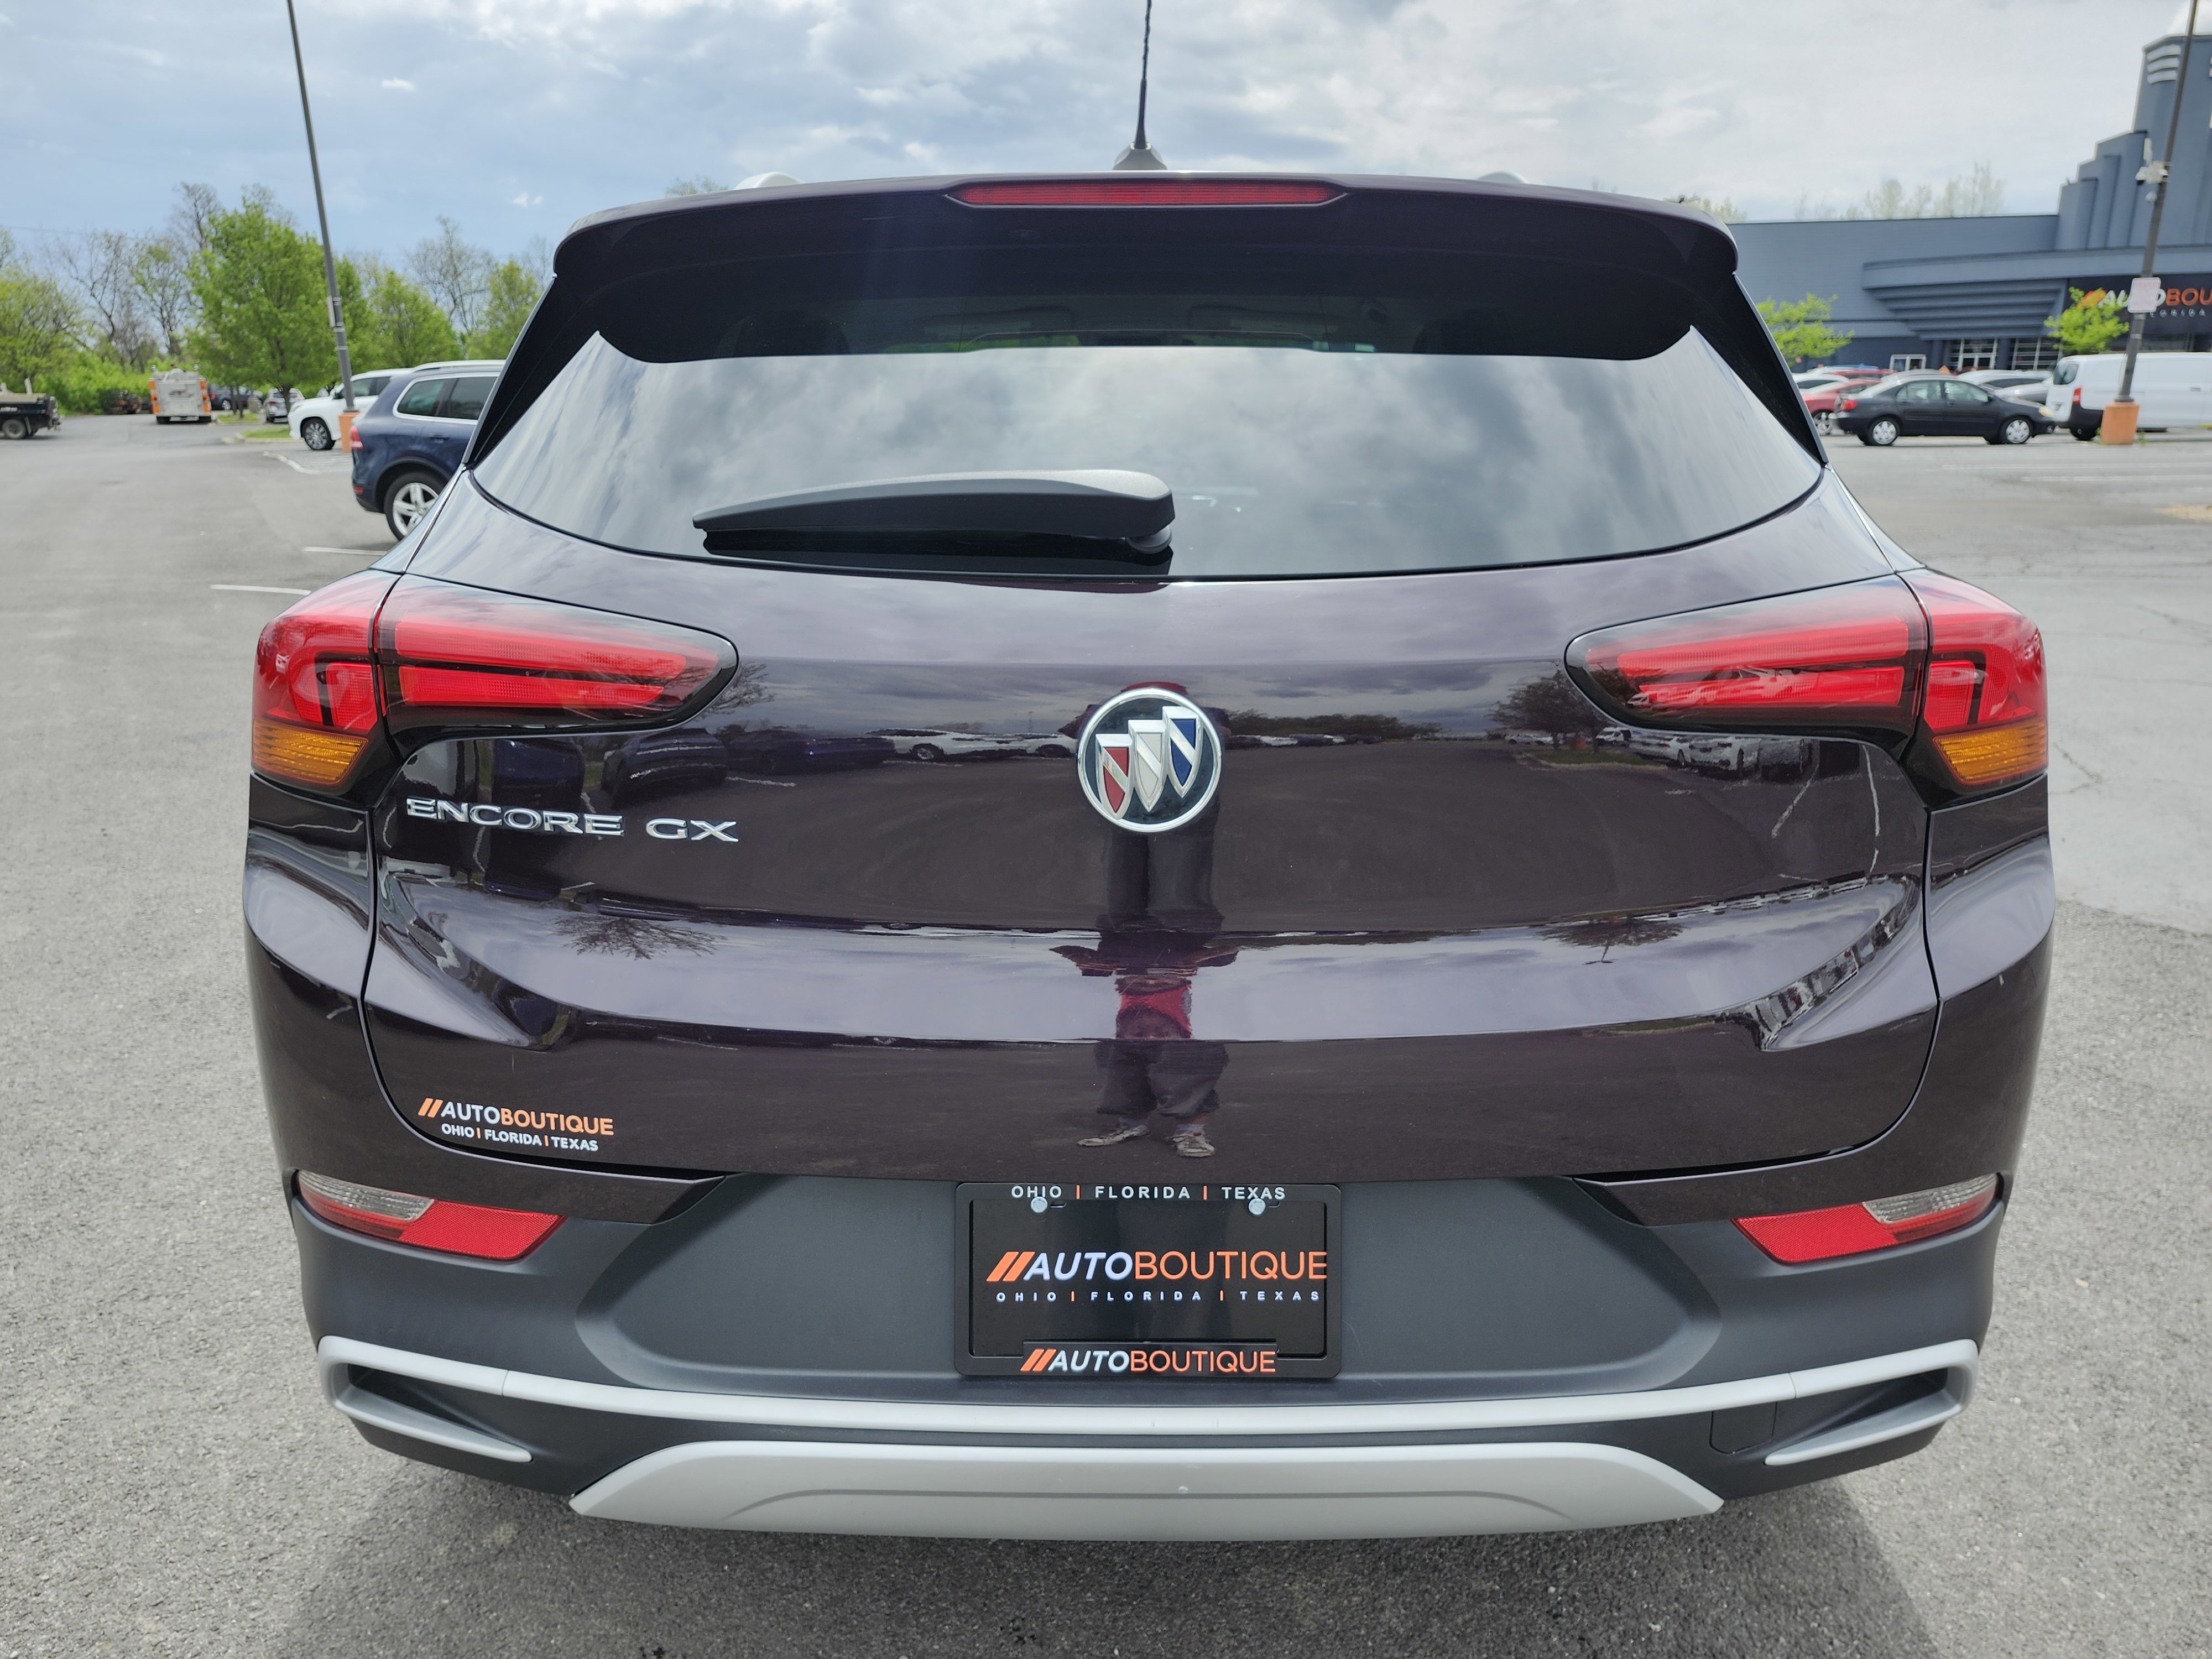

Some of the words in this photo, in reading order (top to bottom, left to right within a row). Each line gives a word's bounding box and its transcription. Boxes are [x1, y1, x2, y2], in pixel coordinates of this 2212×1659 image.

[406, 797, 625, 837] ENCORE
[645, 818, 739, 843] GX
[441, 1101, 614, 1136] AUTOBOUTIQUE
[441, 1123, 475, 1139] OHIO
[484, 1129, 542, 1146] FLORIDA
[551, 1136, 599, 1152] TEXAS
[1011, 1185, 1062, 1199] OHIO
[1094, 1185, 1191, 1199] FLORIDA
[1221, 1186, 1286, 1199] TEXAS
[1023, 1251, 1328, 1281] AUTOBOUTIQUE
[996, 1291, 1057, 1302] OHIO
[1090, 1291, 1201, 1302] FLORIDA
[1239, 1290, 1321, 1302] TEXAS
[1048, 1350, 1276, 1373] AUTOBOUTIQUE
